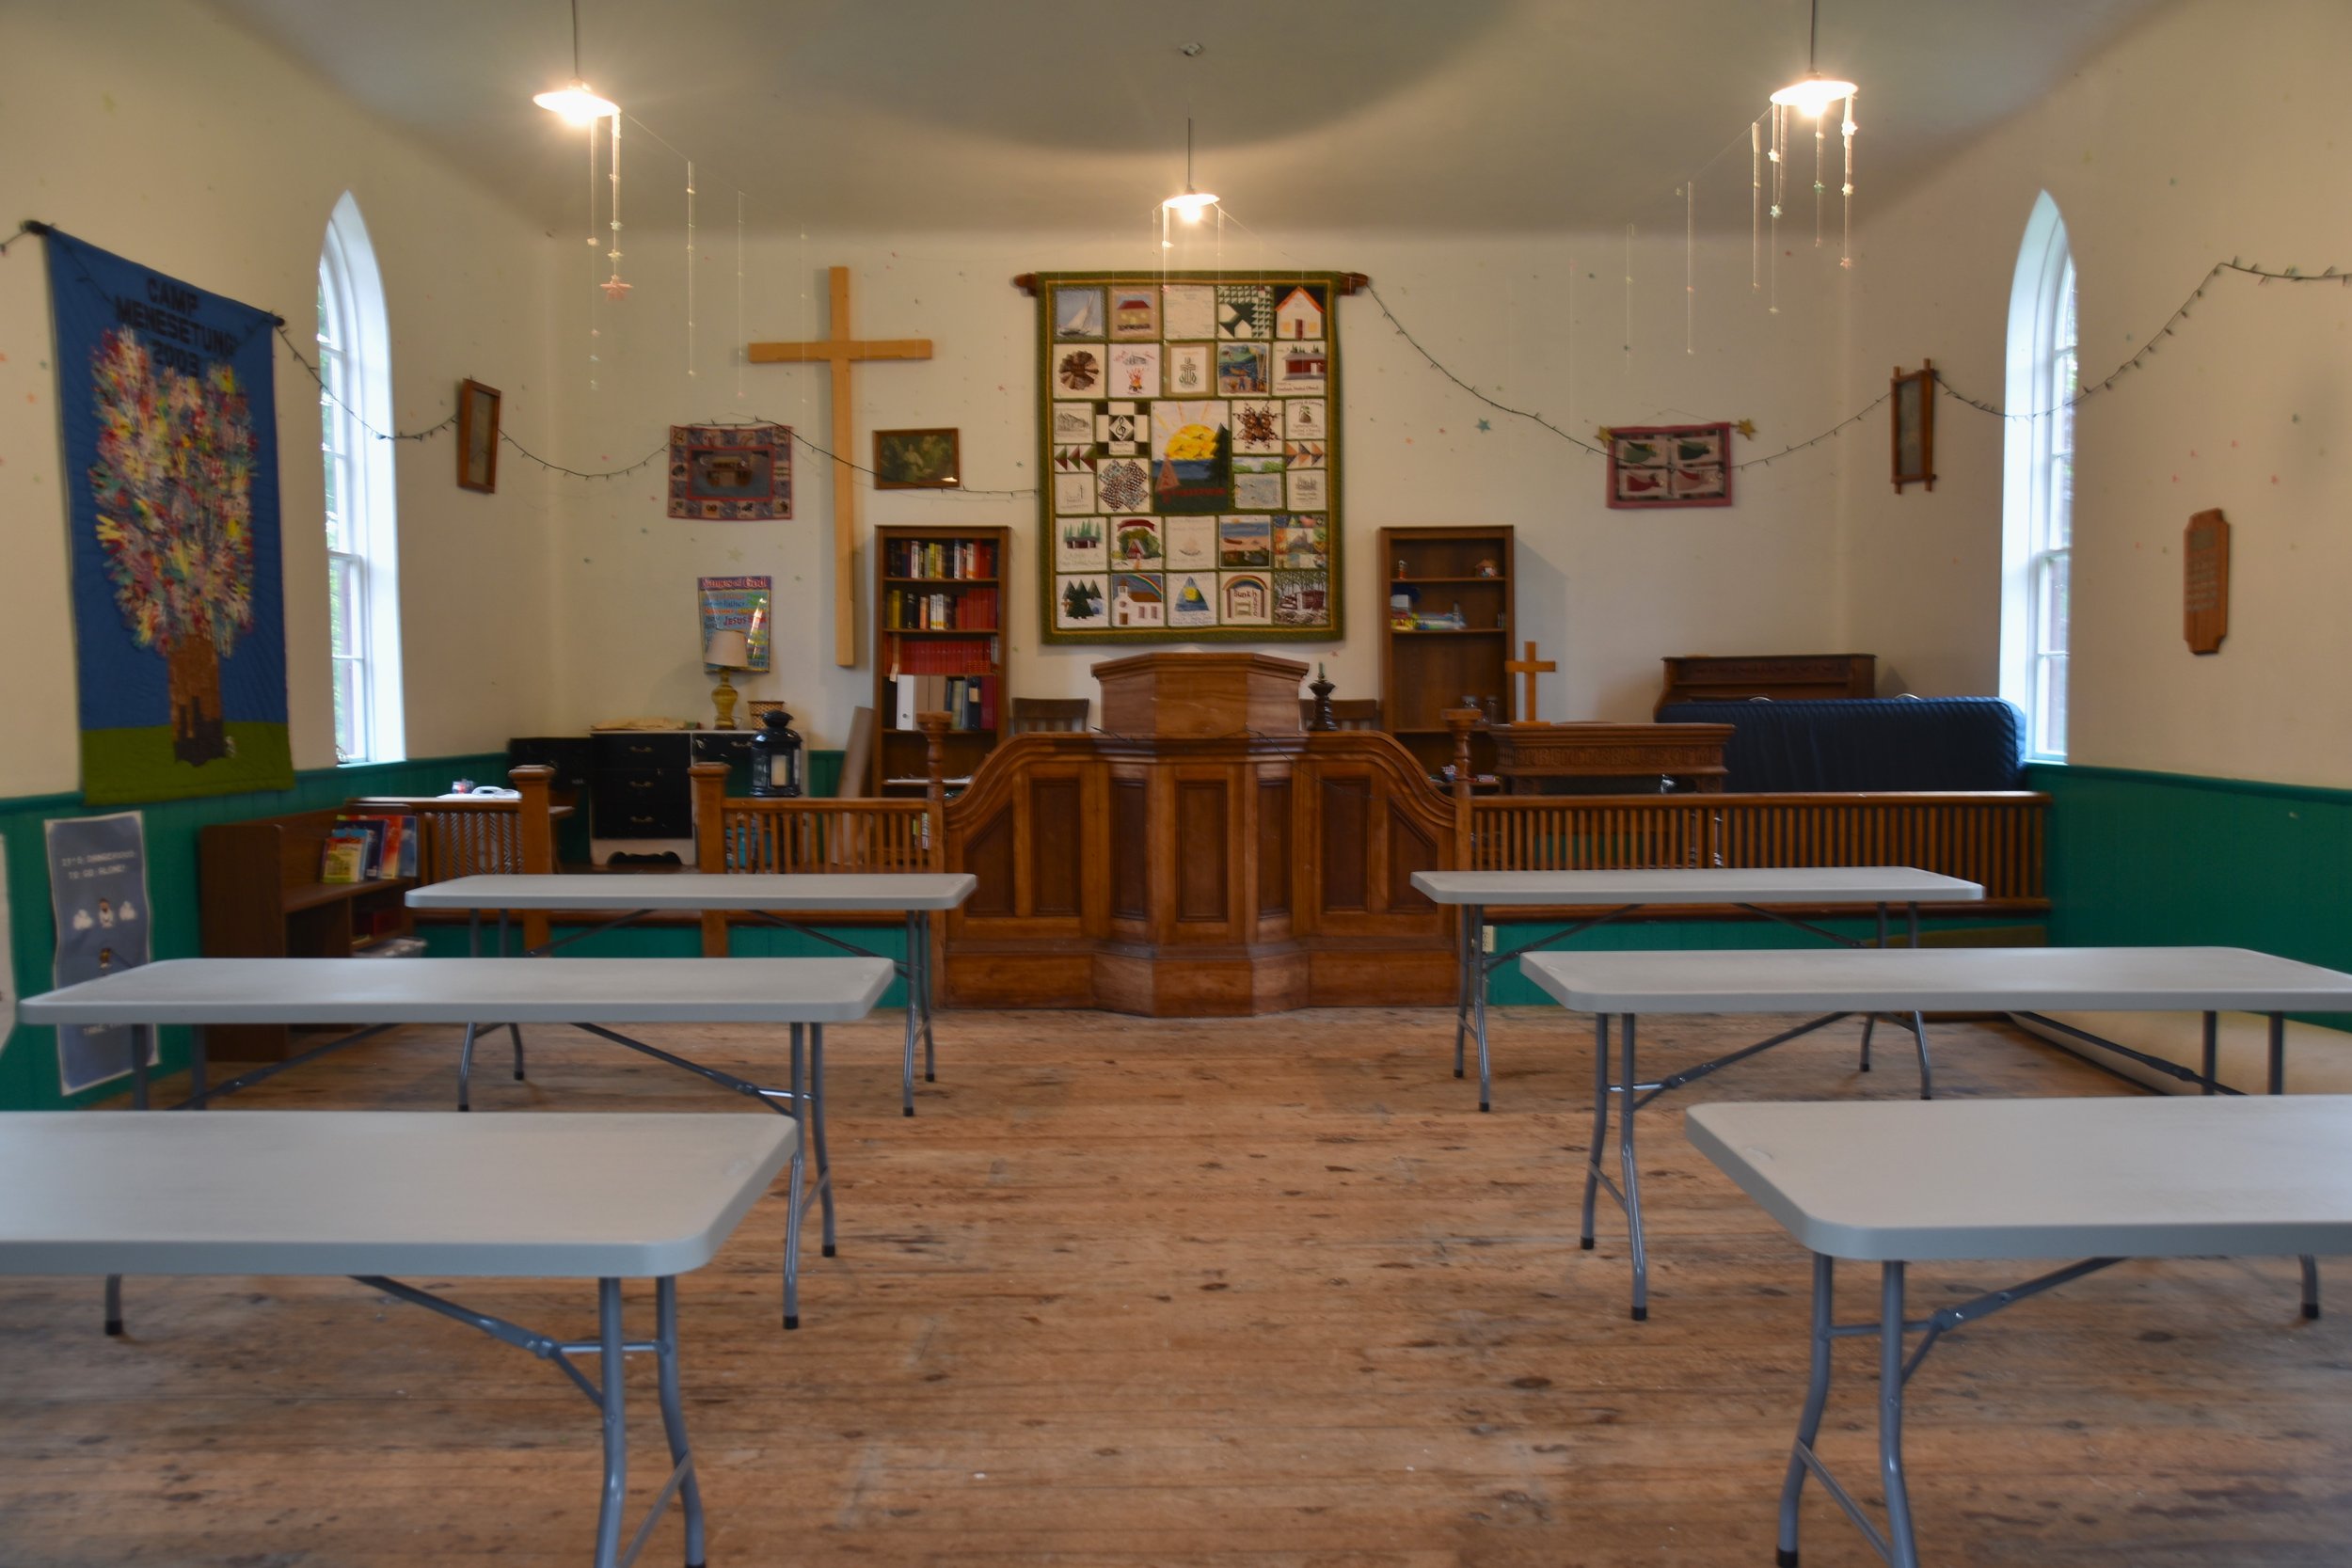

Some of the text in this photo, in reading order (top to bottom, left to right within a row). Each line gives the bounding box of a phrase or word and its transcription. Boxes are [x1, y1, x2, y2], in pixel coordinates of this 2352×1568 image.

[147, 277, 199, 316] CAMP
[702, 578, 732, 589] Names
[743, 577, 767, 589] God
[723, 616, 747, 626] JESUS
